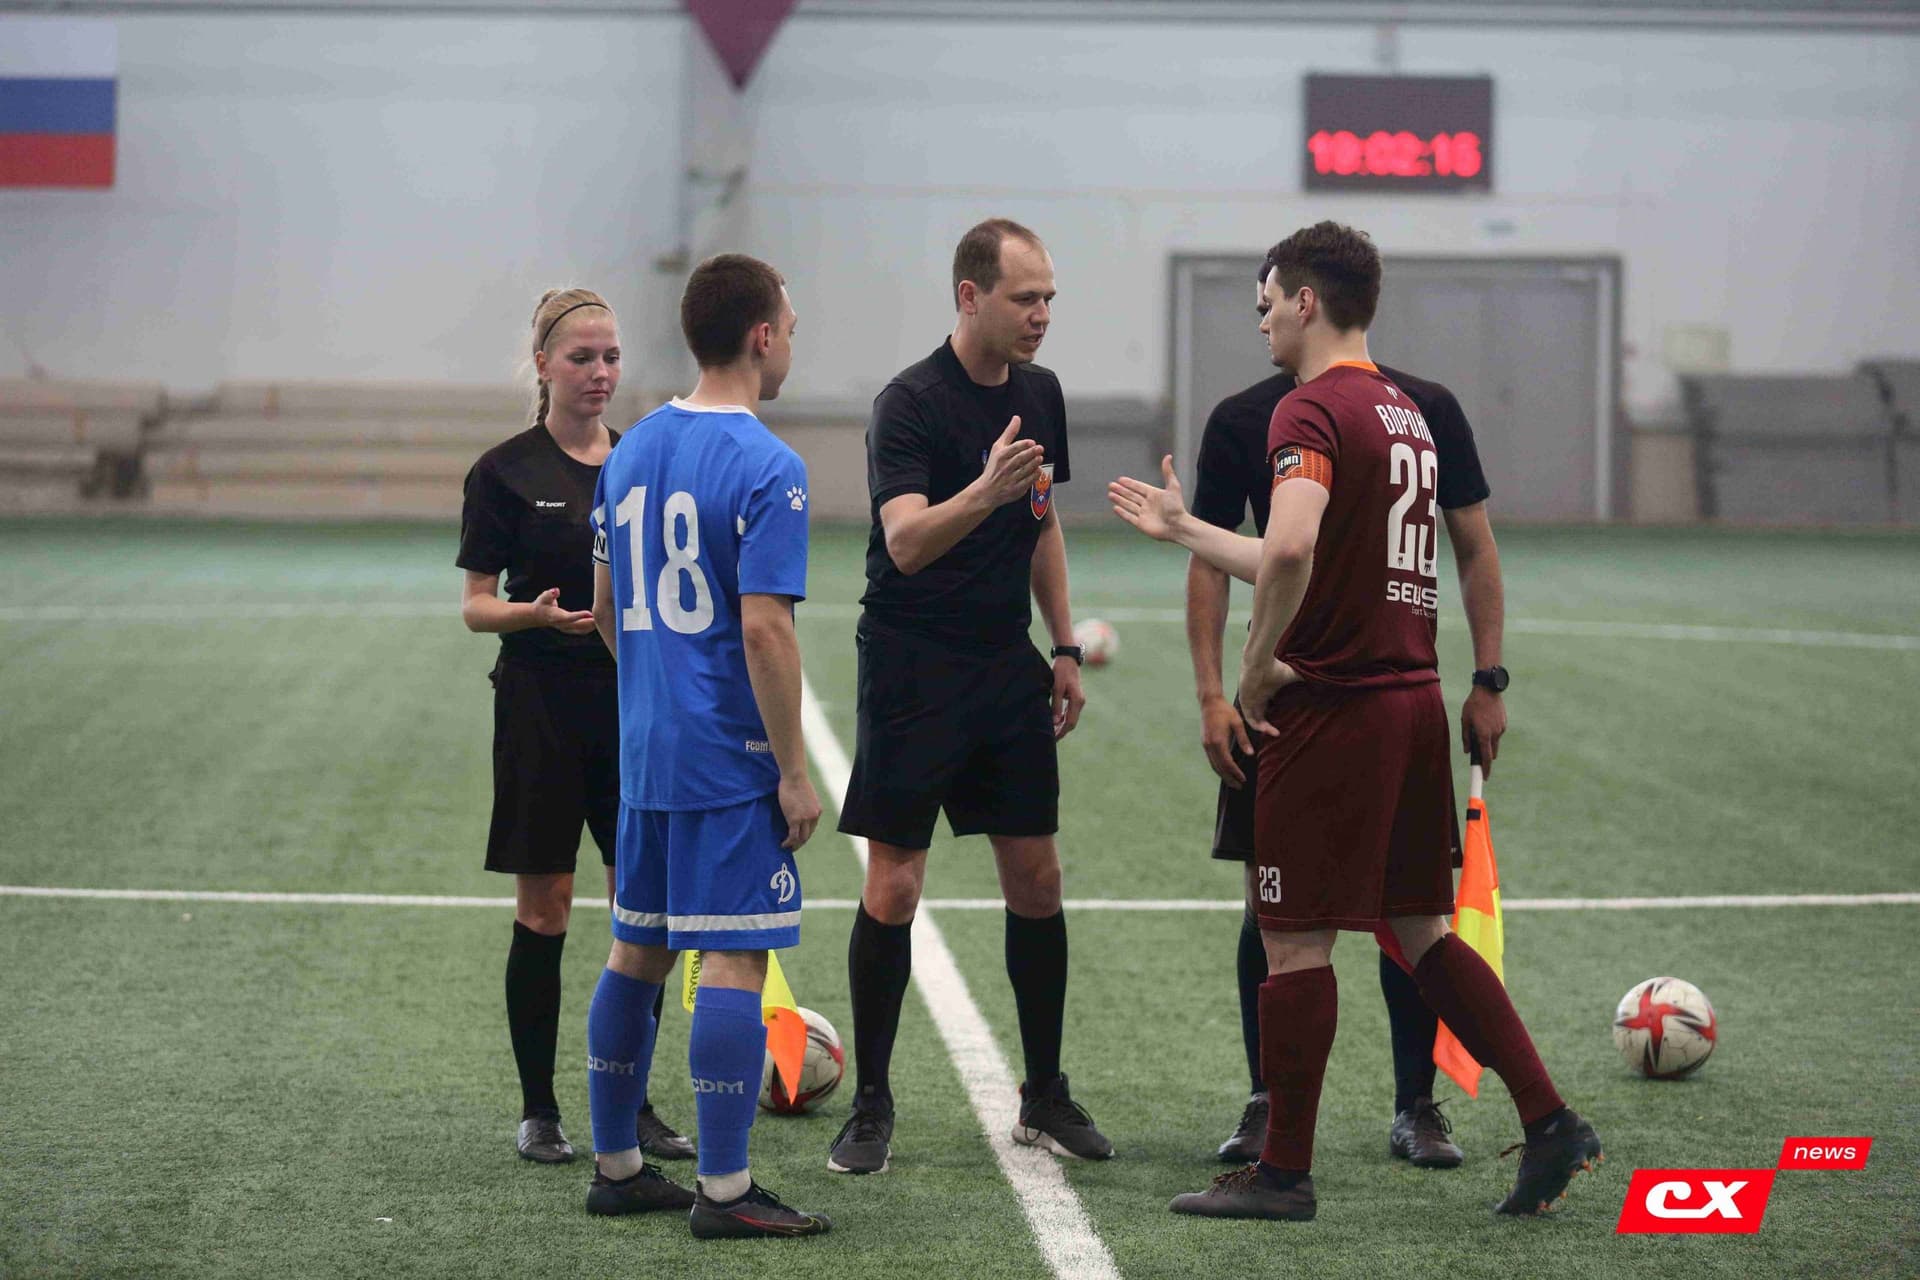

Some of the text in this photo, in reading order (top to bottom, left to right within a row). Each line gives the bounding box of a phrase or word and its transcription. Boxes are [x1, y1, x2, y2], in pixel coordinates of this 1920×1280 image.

[1388, 442, 1437, 578] 23
[615, 483, 715, 635] 18
[1385, 580, 1438, 610] SEUS
[1258, 865, 1282, 904] 23
